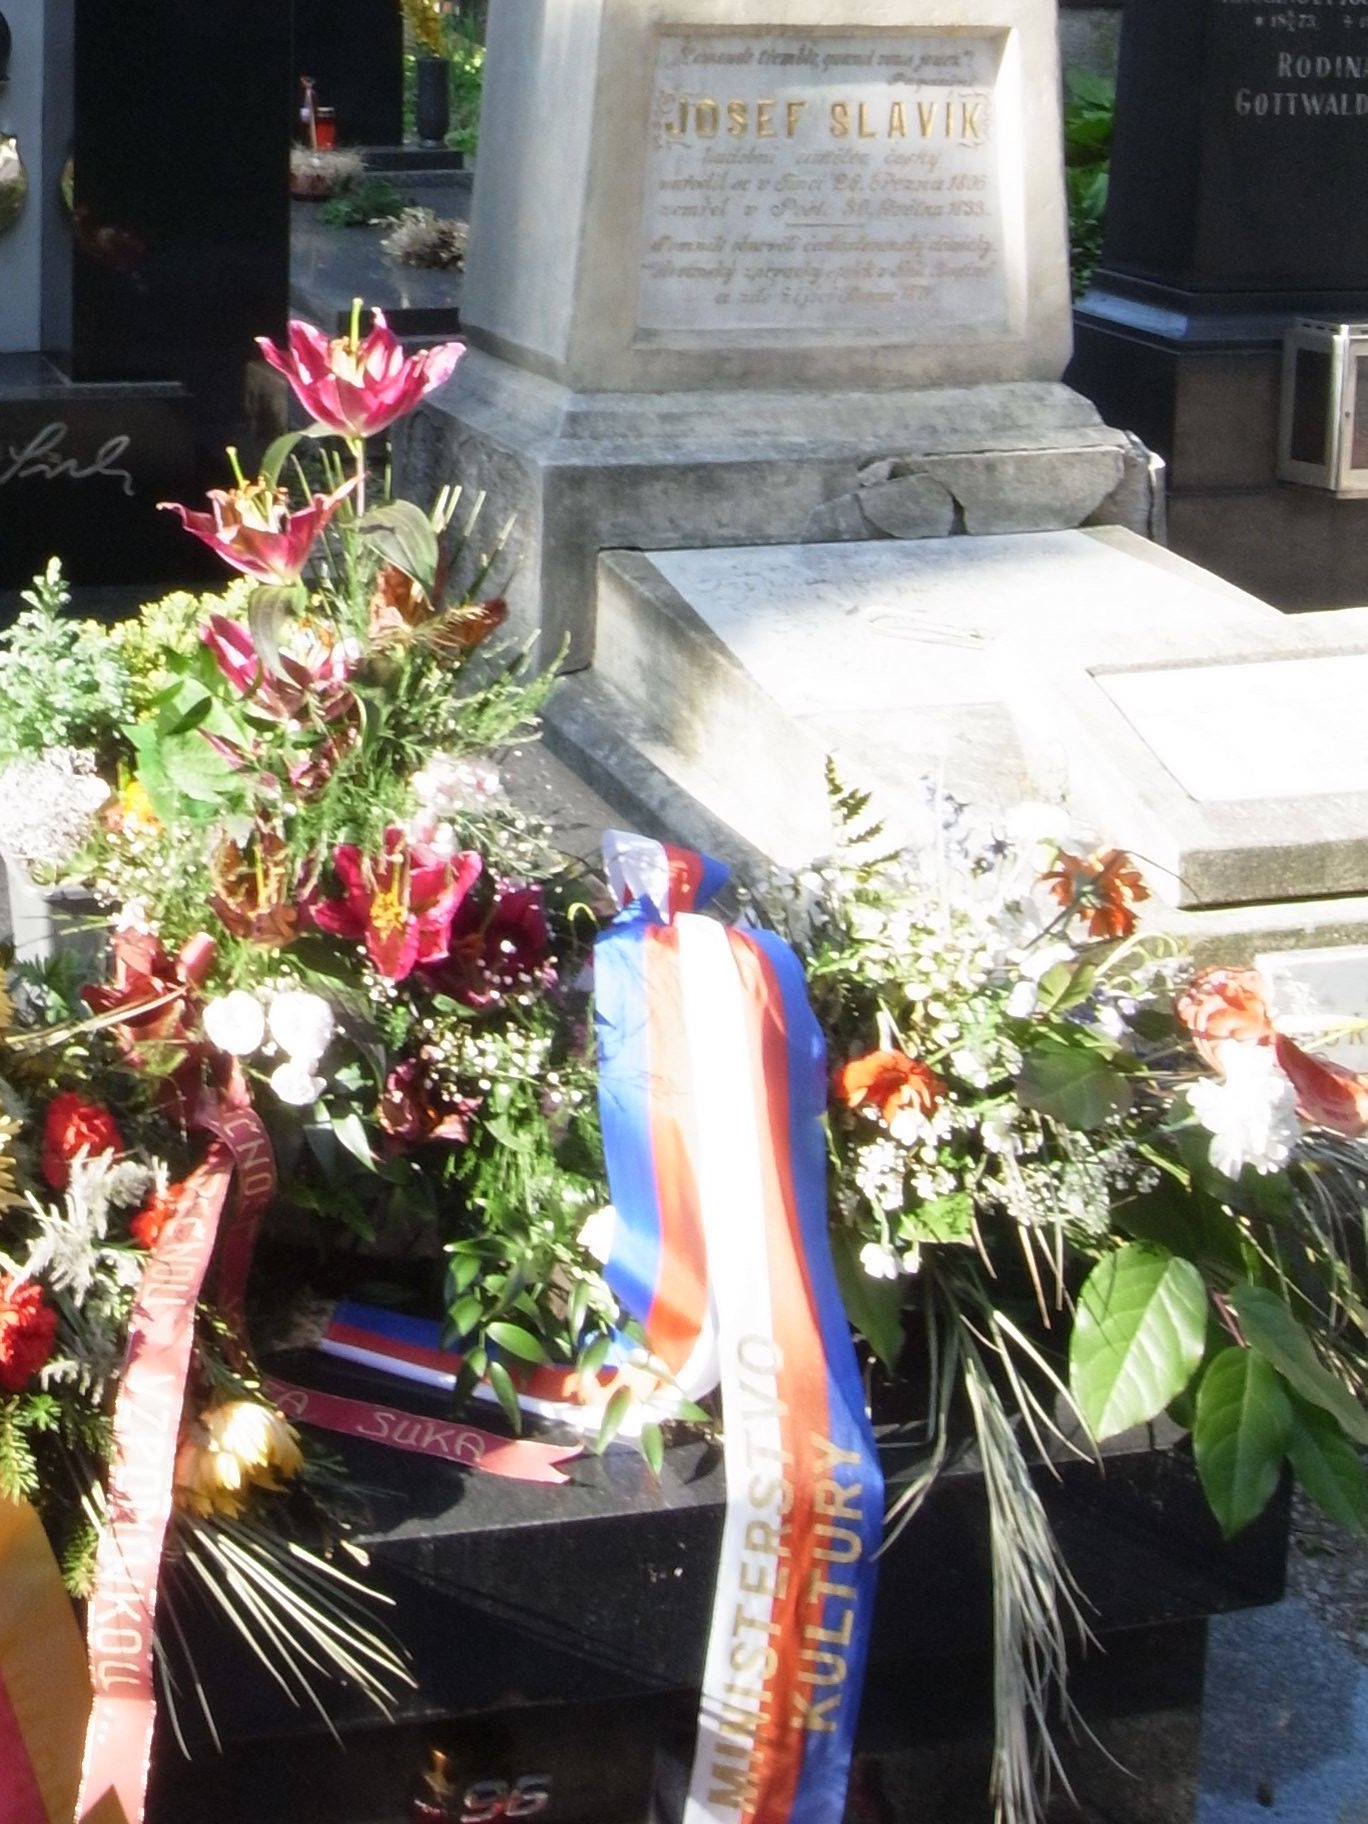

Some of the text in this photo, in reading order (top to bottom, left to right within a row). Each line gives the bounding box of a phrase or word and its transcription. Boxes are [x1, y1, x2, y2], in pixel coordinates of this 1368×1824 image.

[1278, 51, 1368, 79] RODIN
[665, 98, 808, 140] JOSEF
[357, 1410, 488, 1466] SUKA
[708, 1332, 796, 1816] MINISTERSTVO
[790, 1430, 864, 1733] KULTURY
